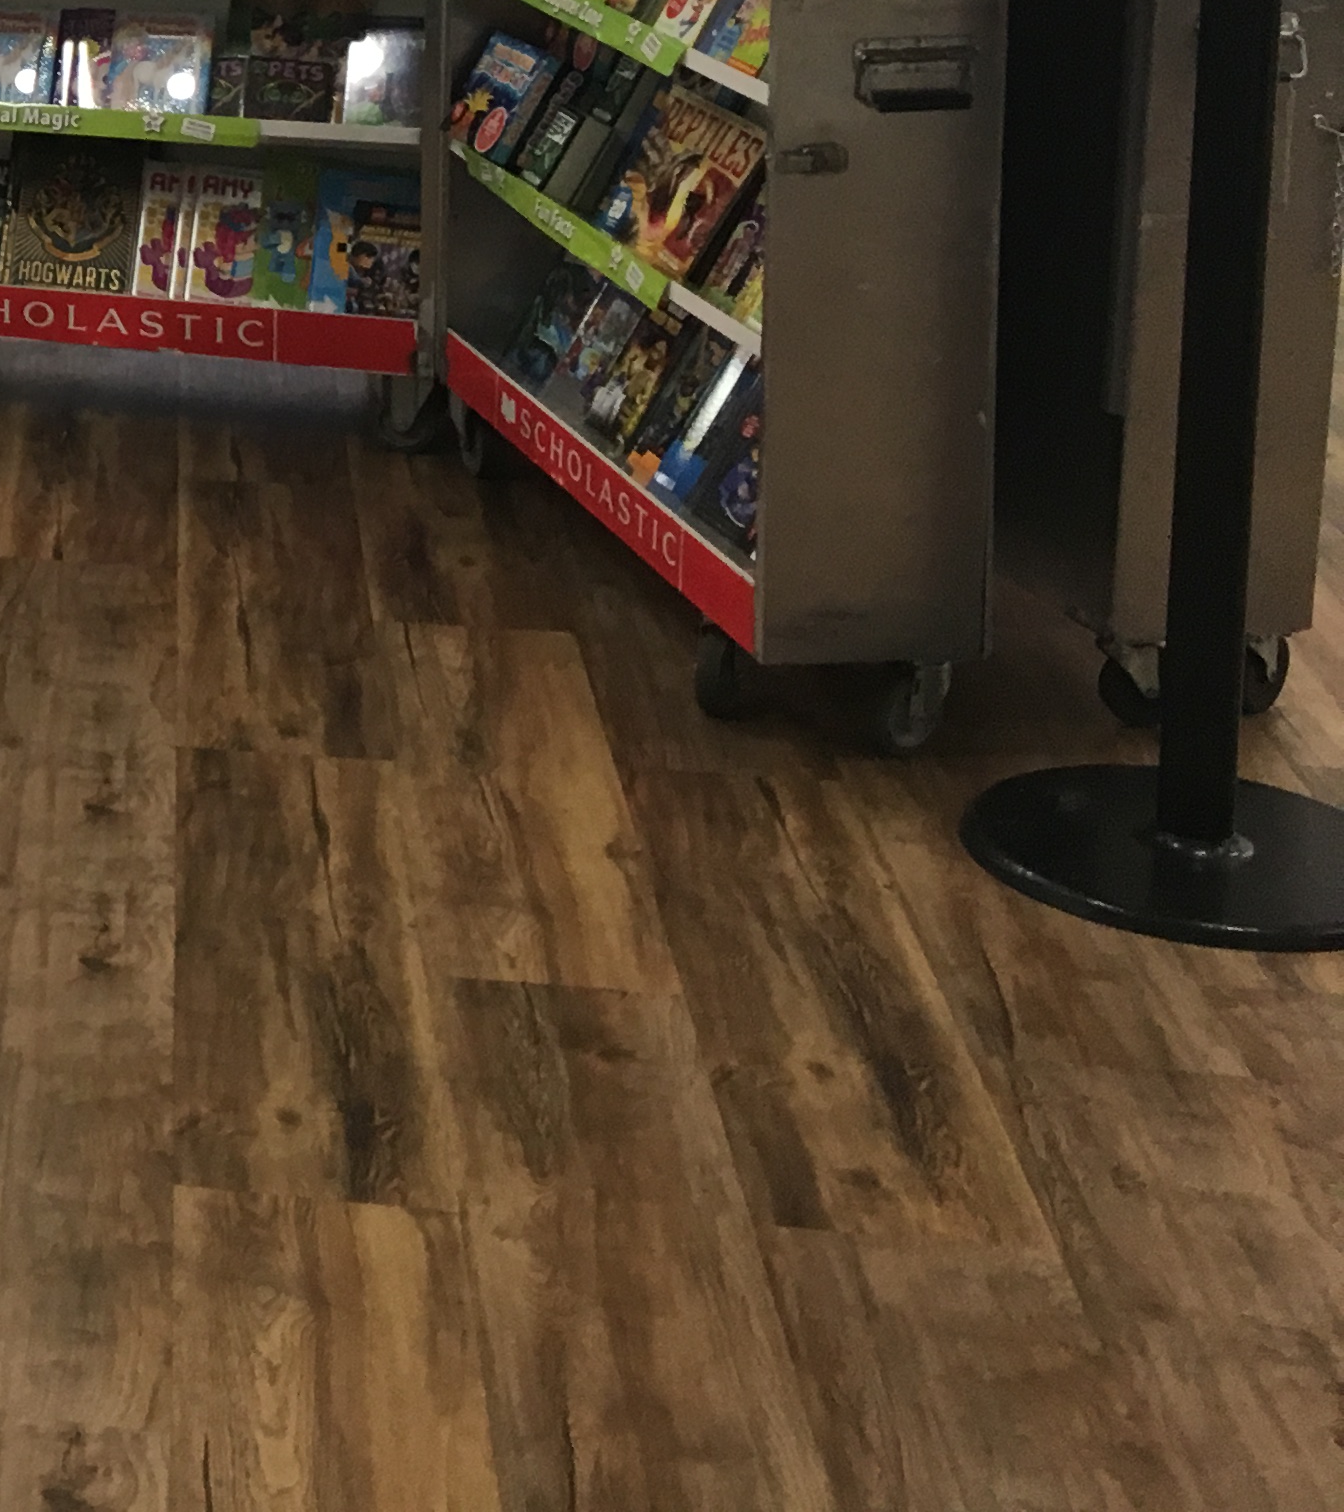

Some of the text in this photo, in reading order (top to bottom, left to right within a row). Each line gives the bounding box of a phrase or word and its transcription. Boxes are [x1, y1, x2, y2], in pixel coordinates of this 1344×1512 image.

[23, 106, 81, 131] Magic
[667, 96, 765, 179] REPTILES
[201, 175, 254, 200] AMY
[18, 260, 122, 291] HOGWARTS
[519, 408, 677, 568] SCHOLASTIC
